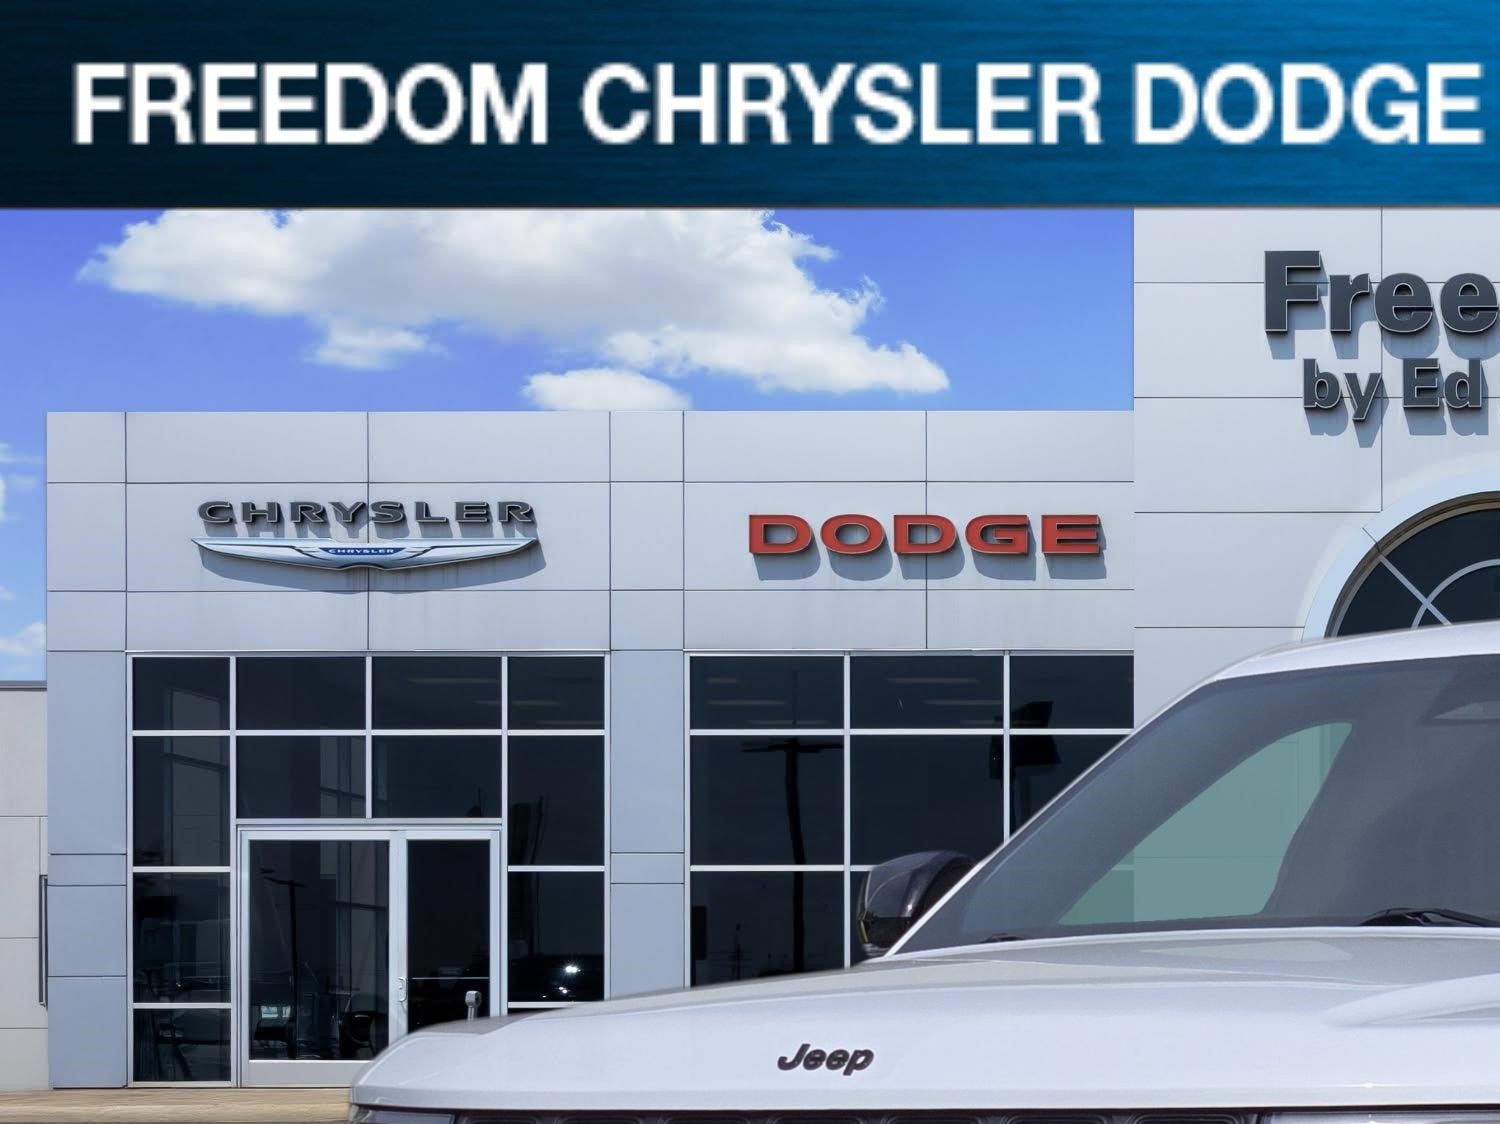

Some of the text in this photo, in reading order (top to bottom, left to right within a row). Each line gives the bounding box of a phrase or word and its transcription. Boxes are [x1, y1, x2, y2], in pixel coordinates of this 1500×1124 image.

[1302, 358, 1382, 422] by
[1401, 358, 1483, 409] Ed
[197, 500, 534, 524] CHRYSLER
[748, 513, 1100, 554] DODGE
[777, 1043, 875, 1076] Jeep
